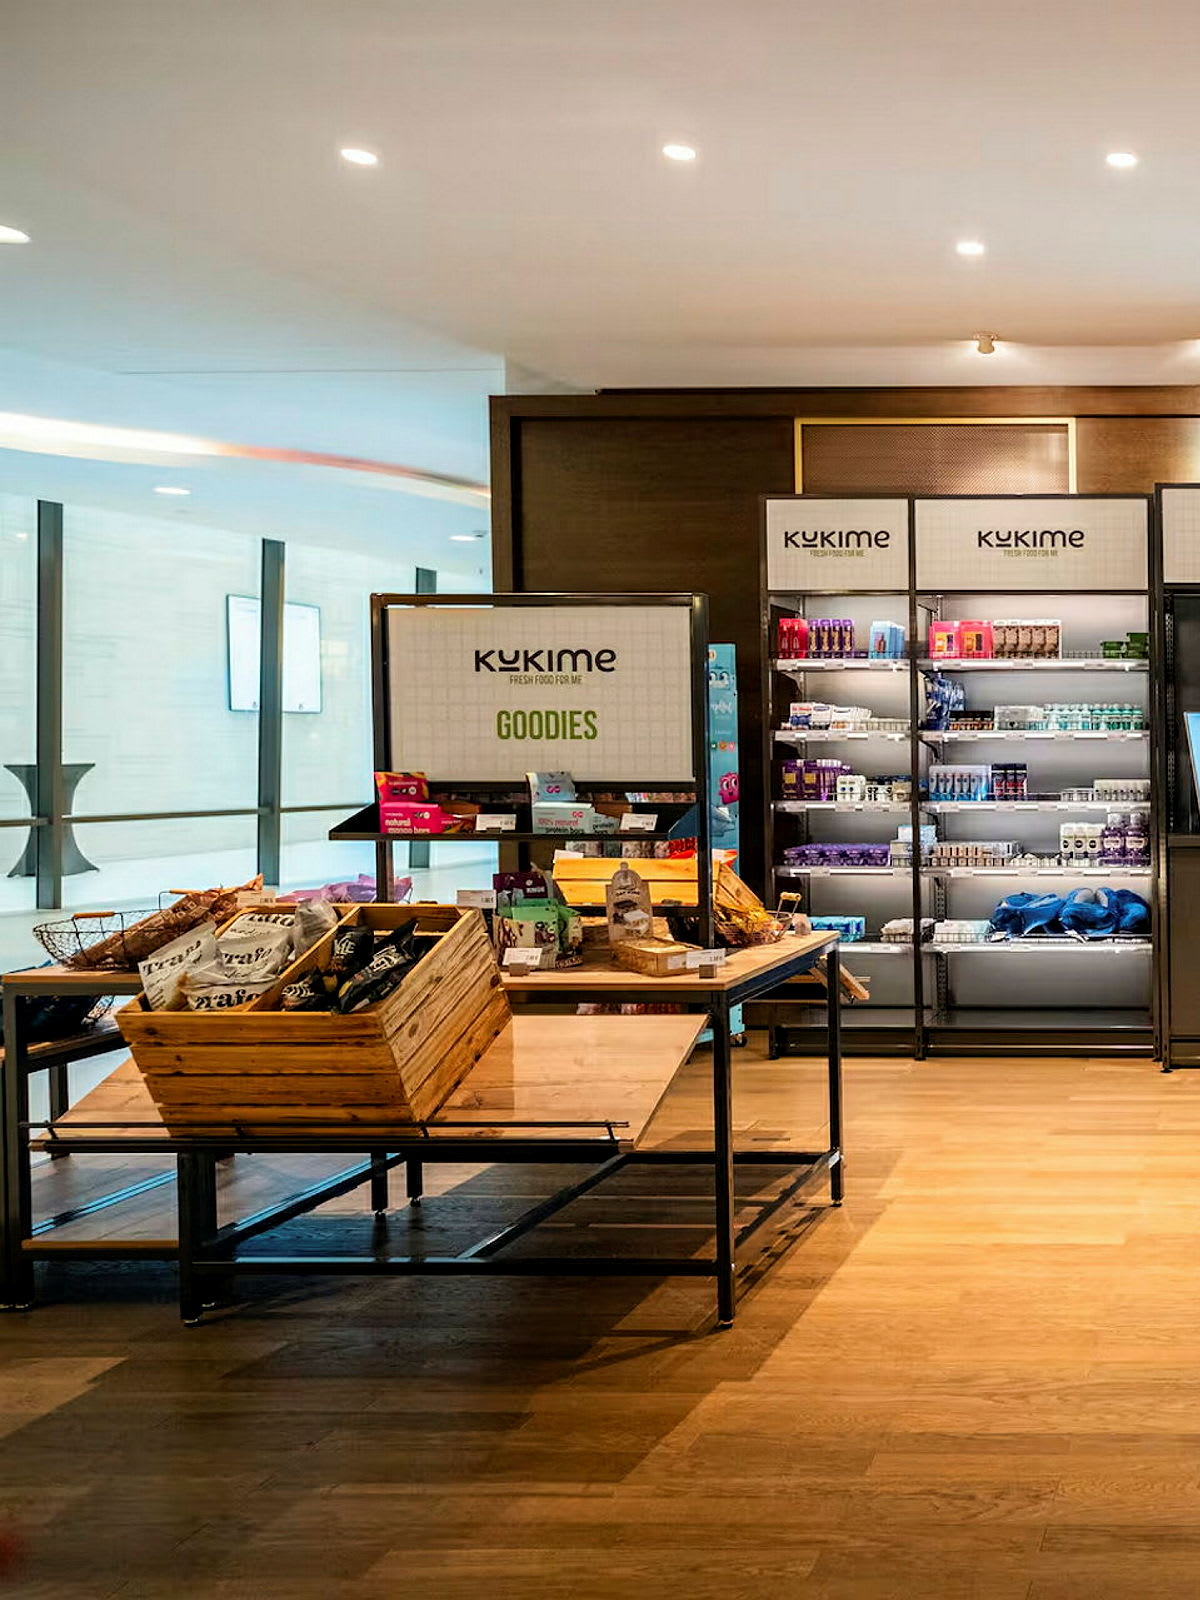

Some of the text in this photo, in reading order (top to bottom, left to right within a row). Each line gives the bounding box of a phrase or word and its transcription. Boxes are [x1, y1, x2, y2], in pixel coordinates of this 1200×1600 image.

[509, 674, 583, 685] FRESH FOOD FOR ME
[496, 709, 599, 741] GOODIES
